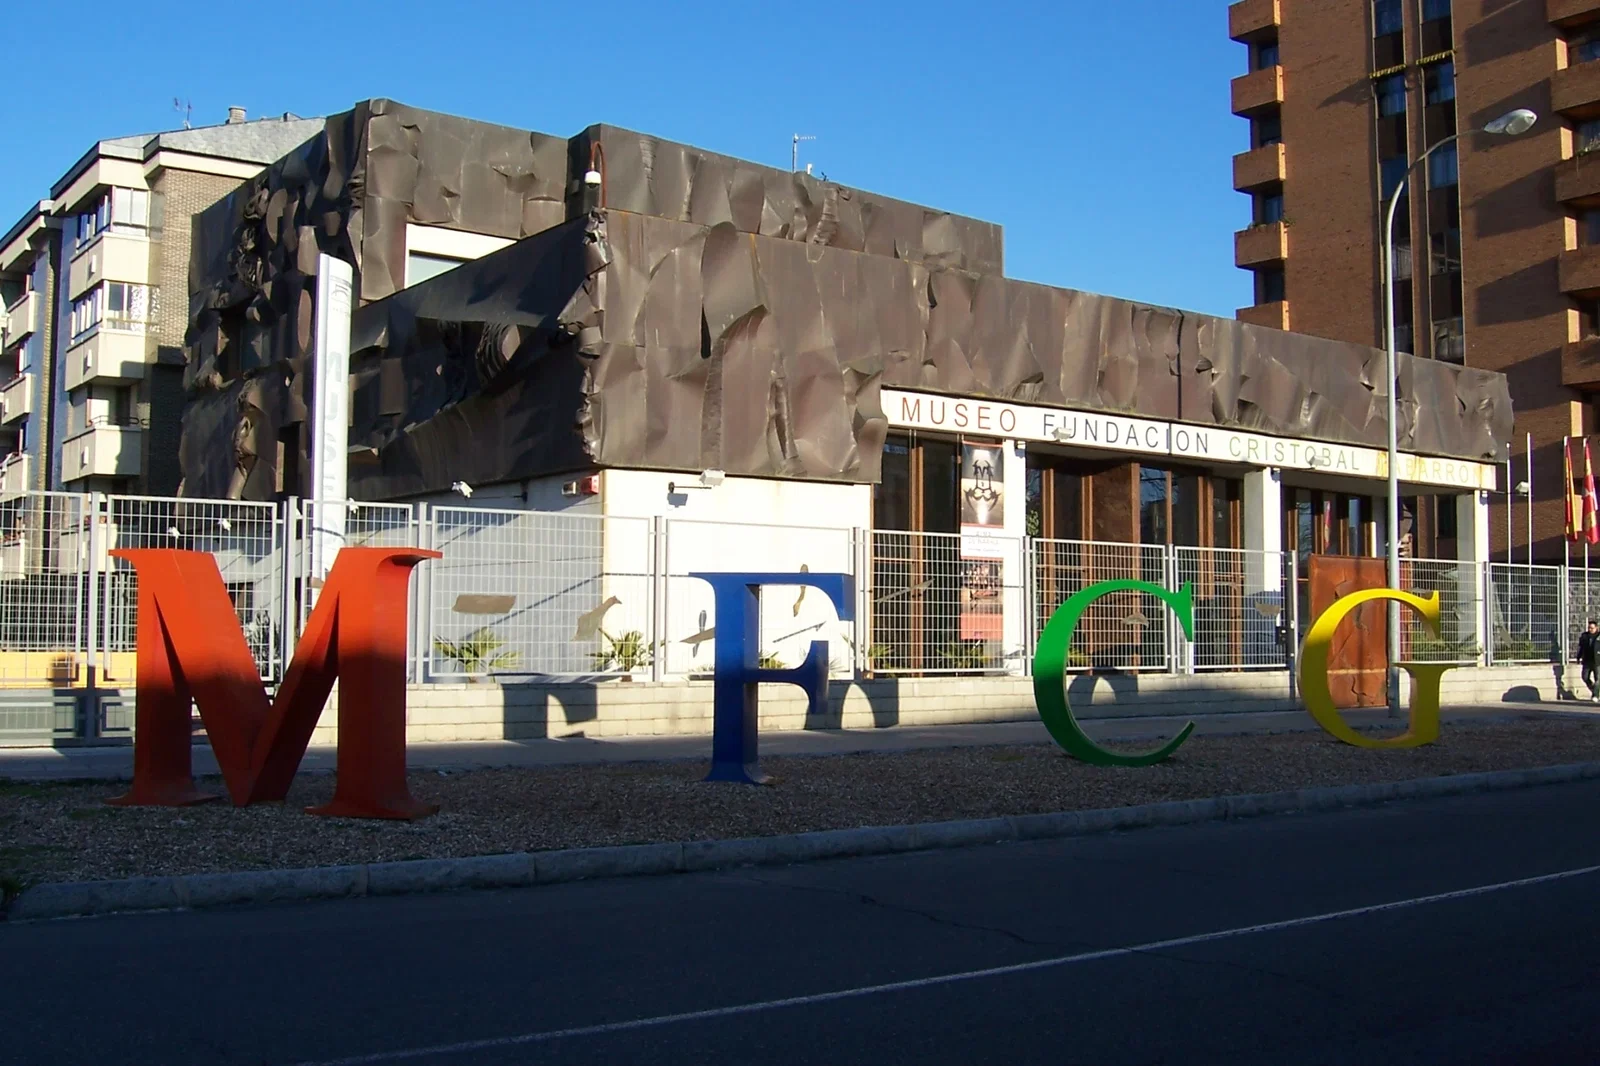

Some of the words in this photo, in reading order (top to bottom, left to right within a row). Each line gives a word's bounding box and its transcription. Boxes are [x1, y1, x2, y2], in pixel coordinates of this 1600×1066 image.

[901, 396, 1017, 433] MUSEO
[1043, 413, 1209, 454] FUNDACION
[1229, 435, 1360, 471] CRISTOBAL
[103, 547, 443, 822] M
[688, 572, 854, 787] F
[1033, 579, 1196, 767] C
[1299, 588, 1458, 749] G
